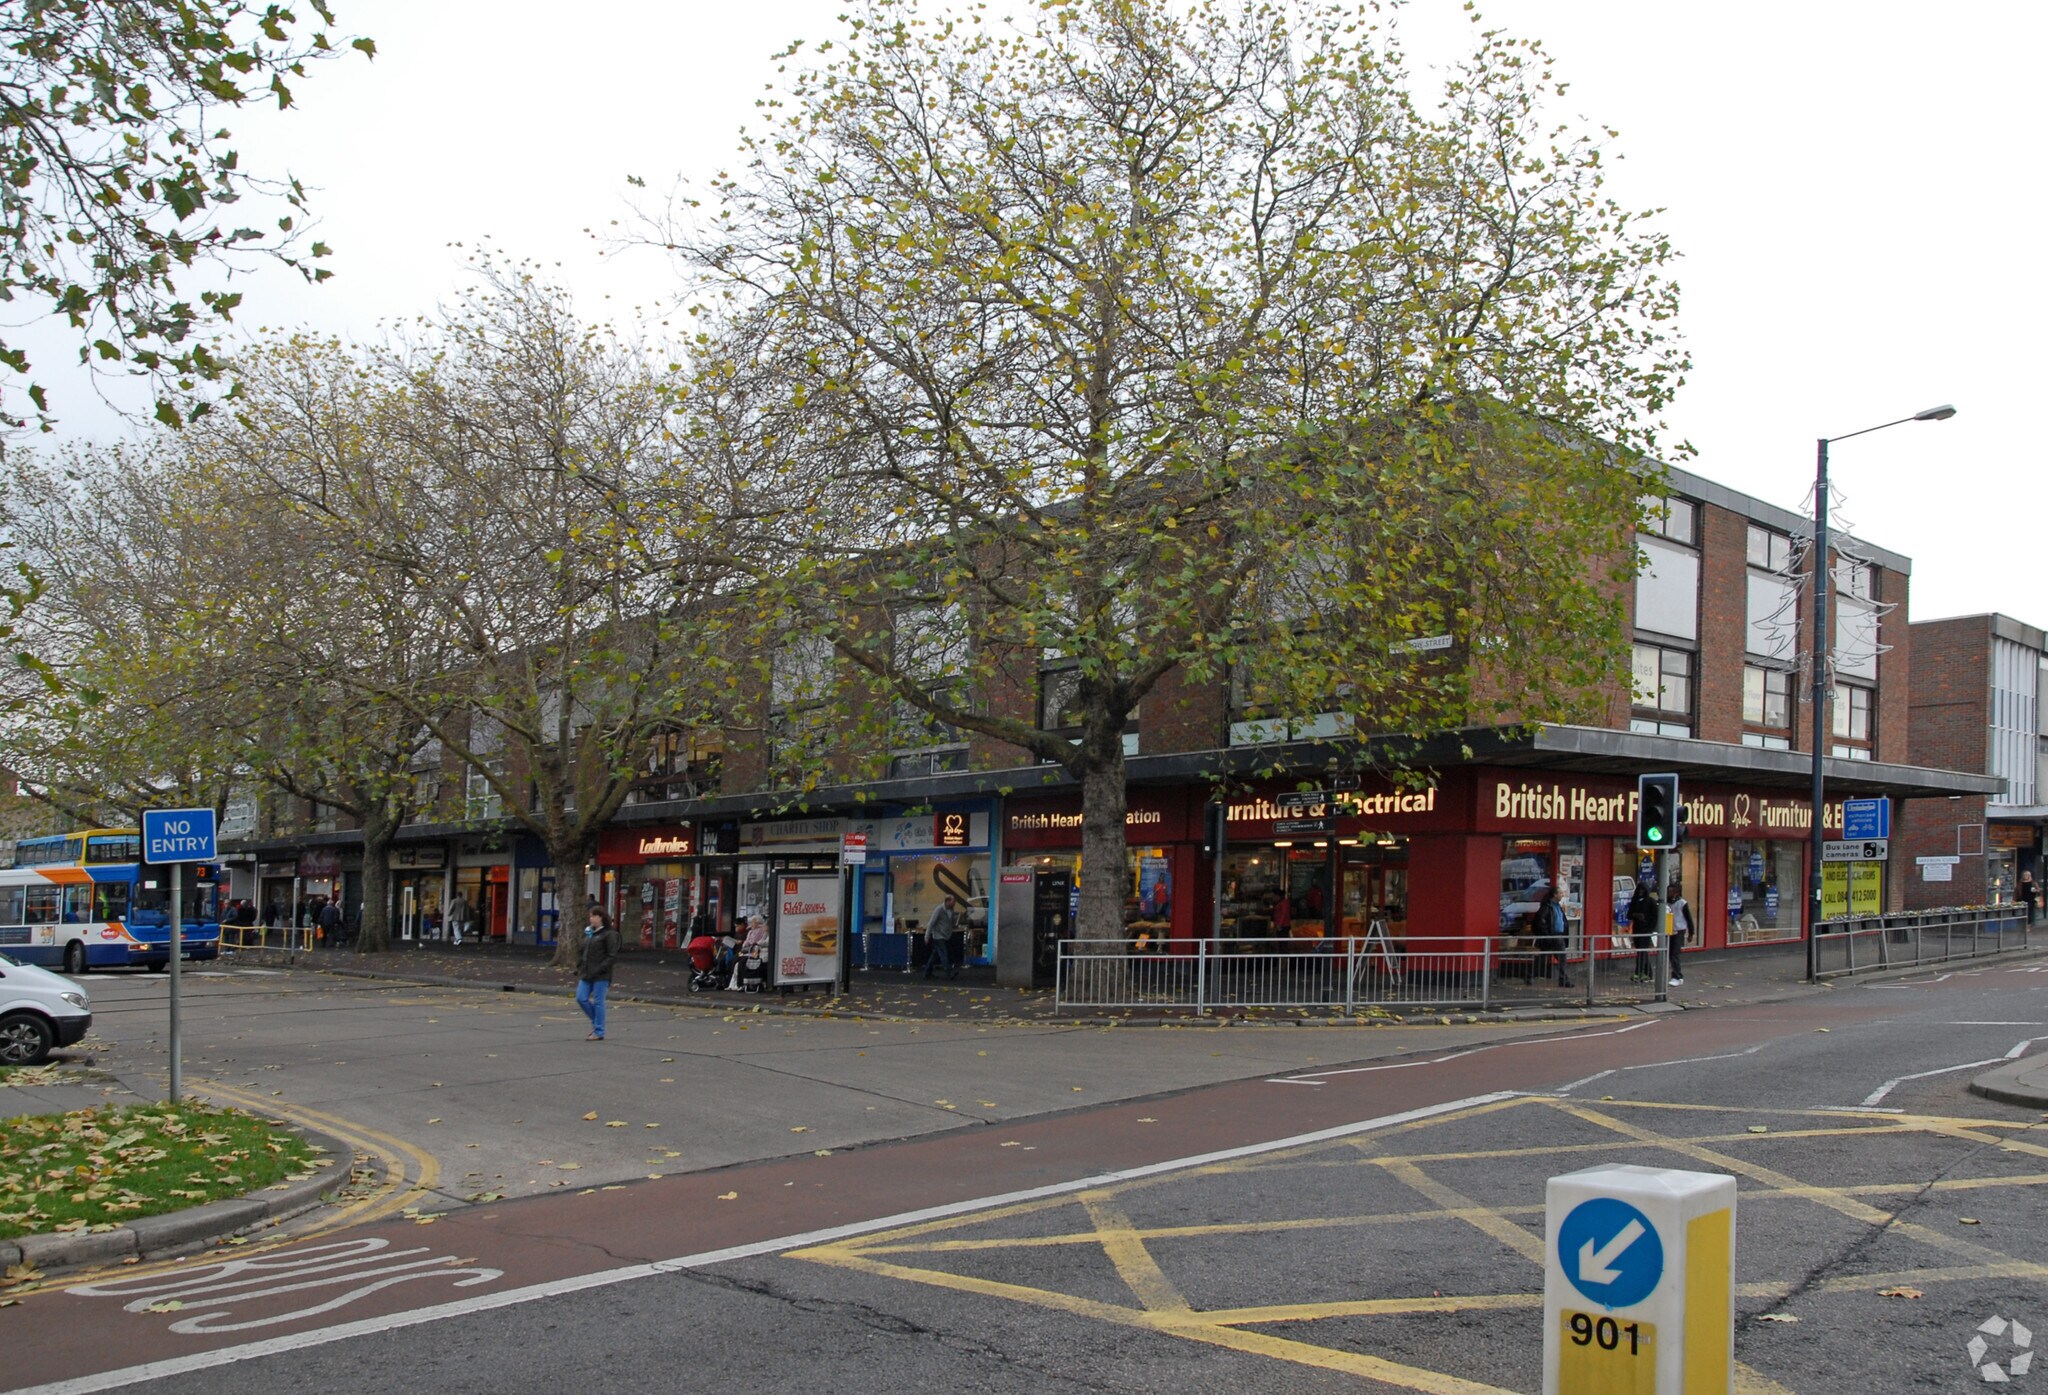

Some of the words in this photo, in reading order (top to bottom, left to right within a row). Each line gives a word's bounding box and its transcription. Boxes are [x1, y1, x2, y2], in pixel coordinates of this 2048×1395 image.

[1425, 637, 1450, 648] STREET
[1226, 799, 1303, 821] urniture
[1496, 783, 1565, 820] British
[1571, 787, 1625, 822] Heart
[1011, 813, 1048, 830] British
[1050, 813, 1083, 829] Heart
[1759, 799, 1813, 828] Furnitur
[1823, 803, 1832, 829] &
[164, 820, 191, 835] NO
[770, 822, 809, 836] CHARITY
[812, 819, 840, 833] SHOP
[152, 836, 209, 853] ENTRY
[639, 837, 689, 854] Ladbrokes
[1826, 872, 1835, 881] AND
[1825, 893, 1836, 903] CALL
[1864, 890, 1877, 901] 5000
[64, 1237, 504, 1335] BUS
[1570, 1312, 1639, 1356] 901
